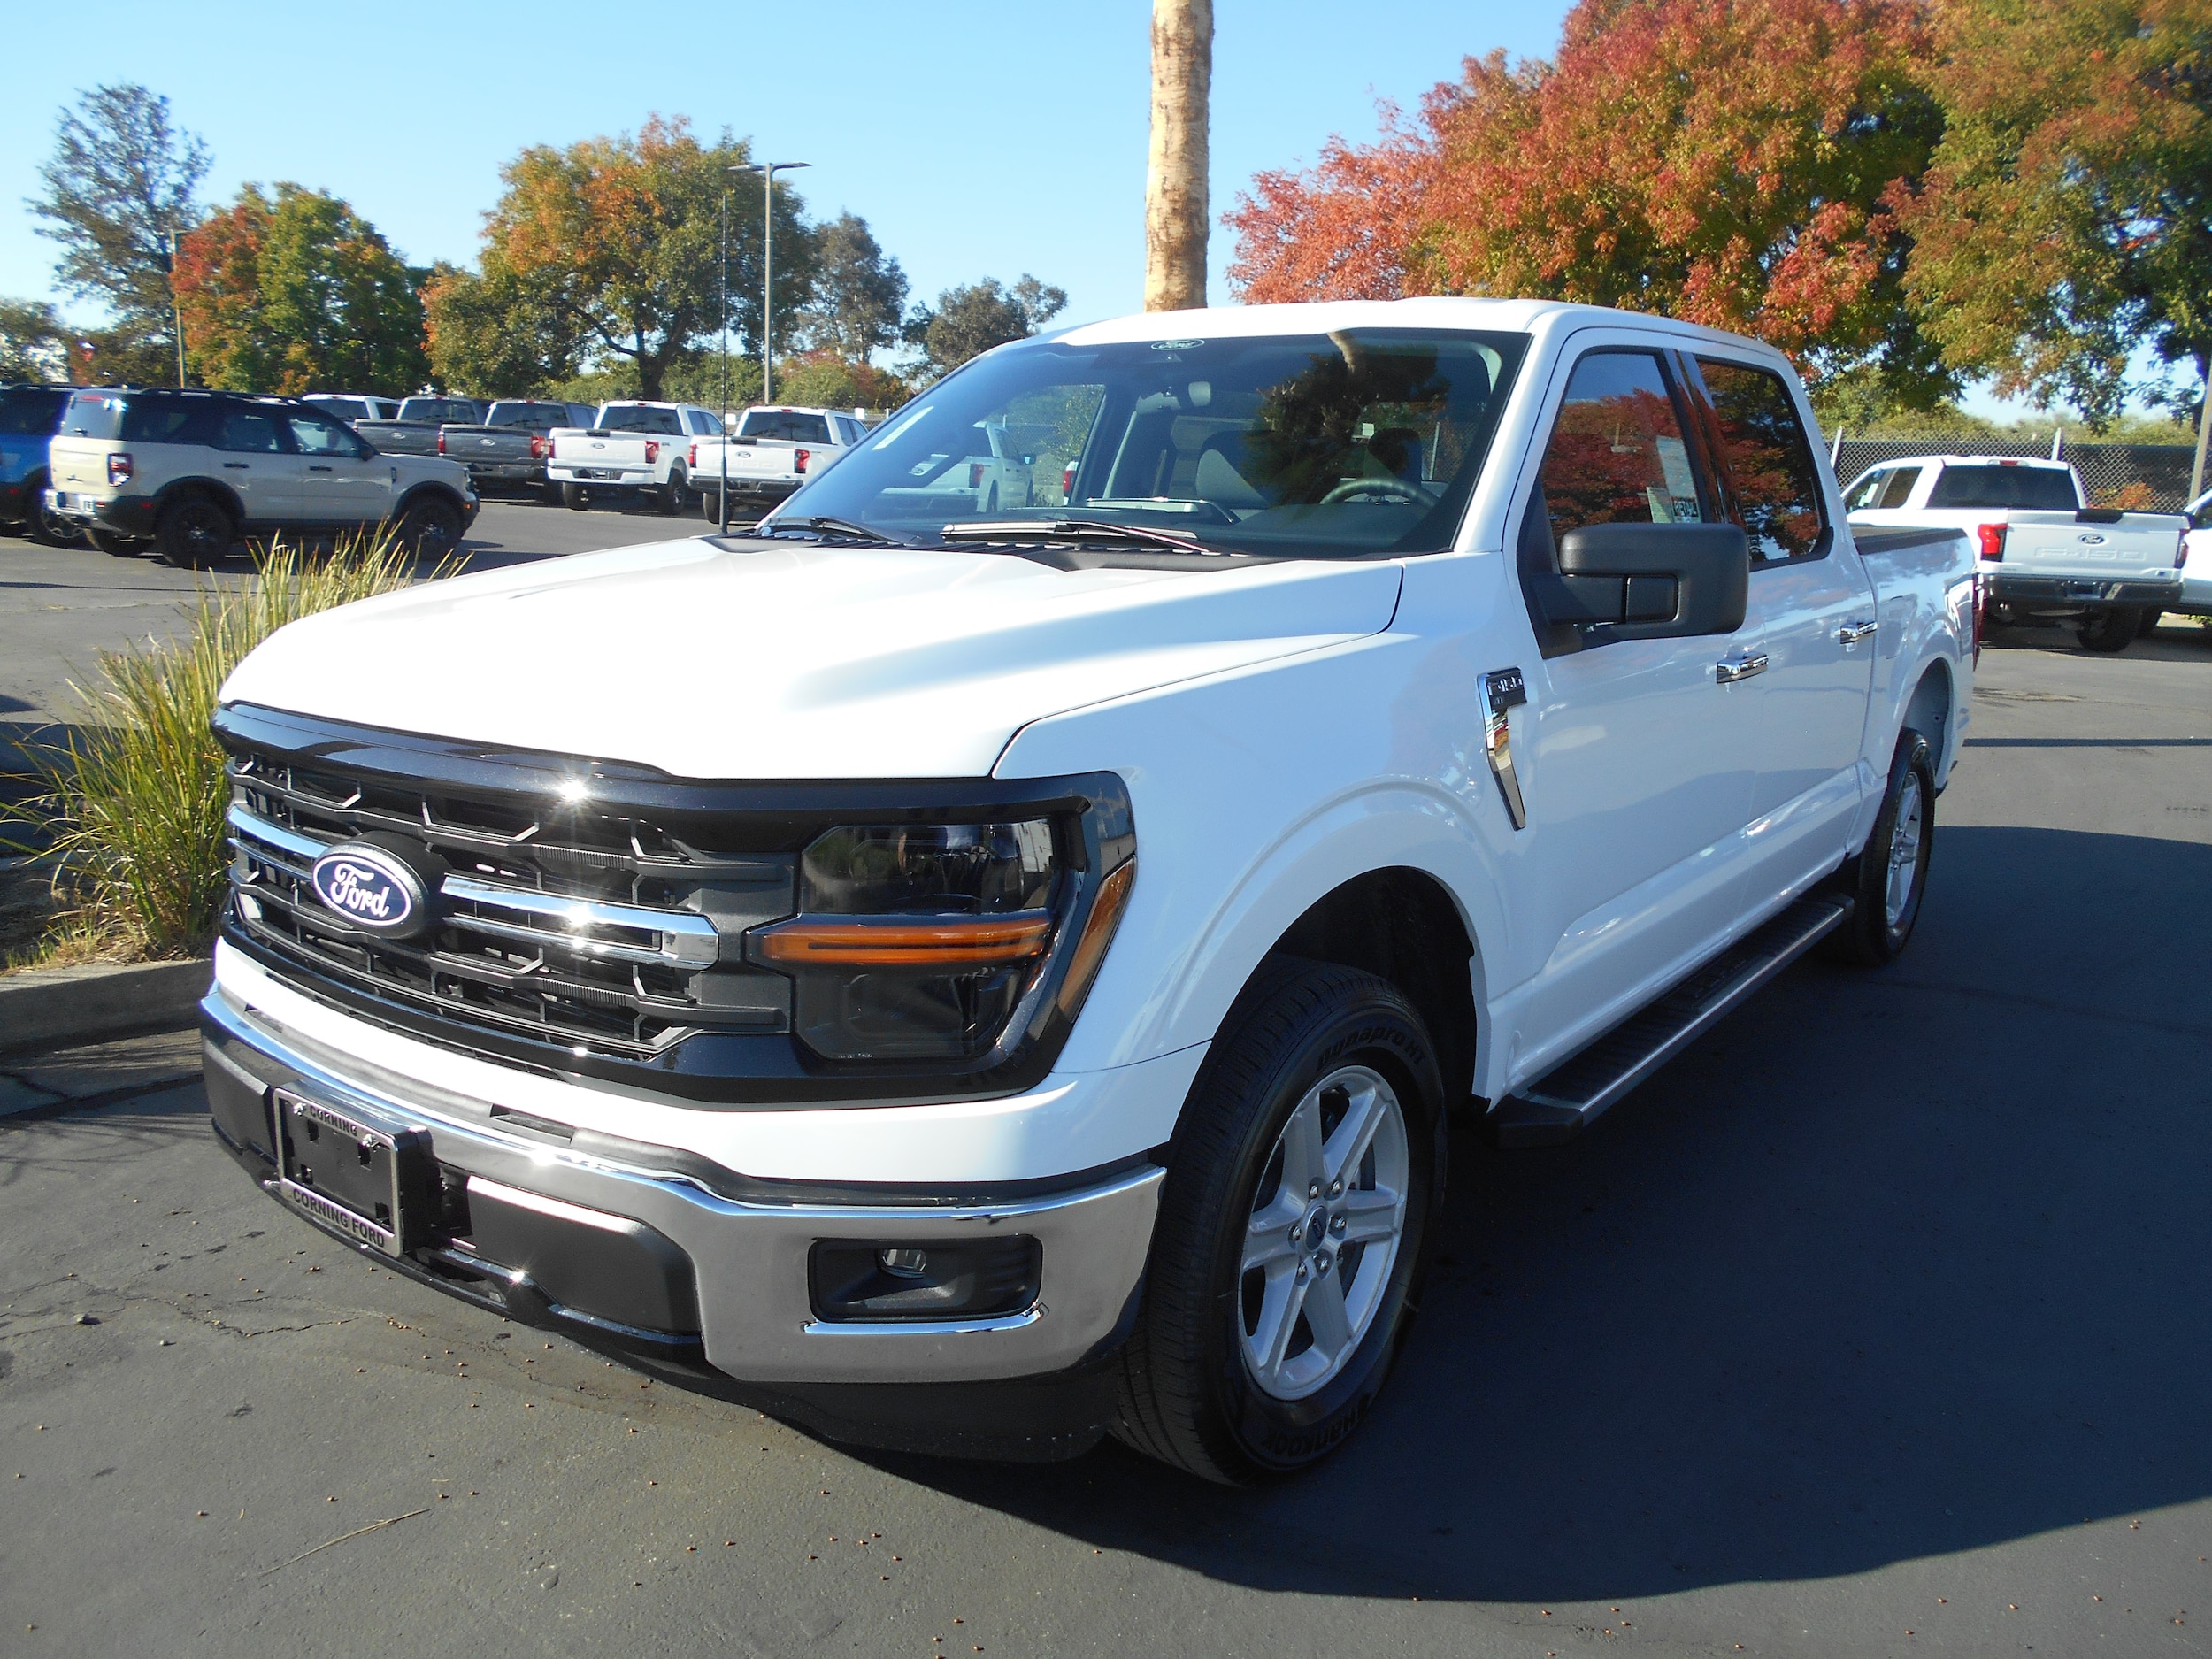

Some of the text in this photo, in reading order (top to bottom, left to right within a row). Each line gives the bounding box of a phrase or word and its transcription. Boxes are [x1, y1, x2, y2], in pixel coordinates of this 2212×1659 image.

[330, 863, 390, 918] Ford
[311, 1106, 358, 1137] CORNING
[293, 1188, 385, 1248] CORNING FORD
